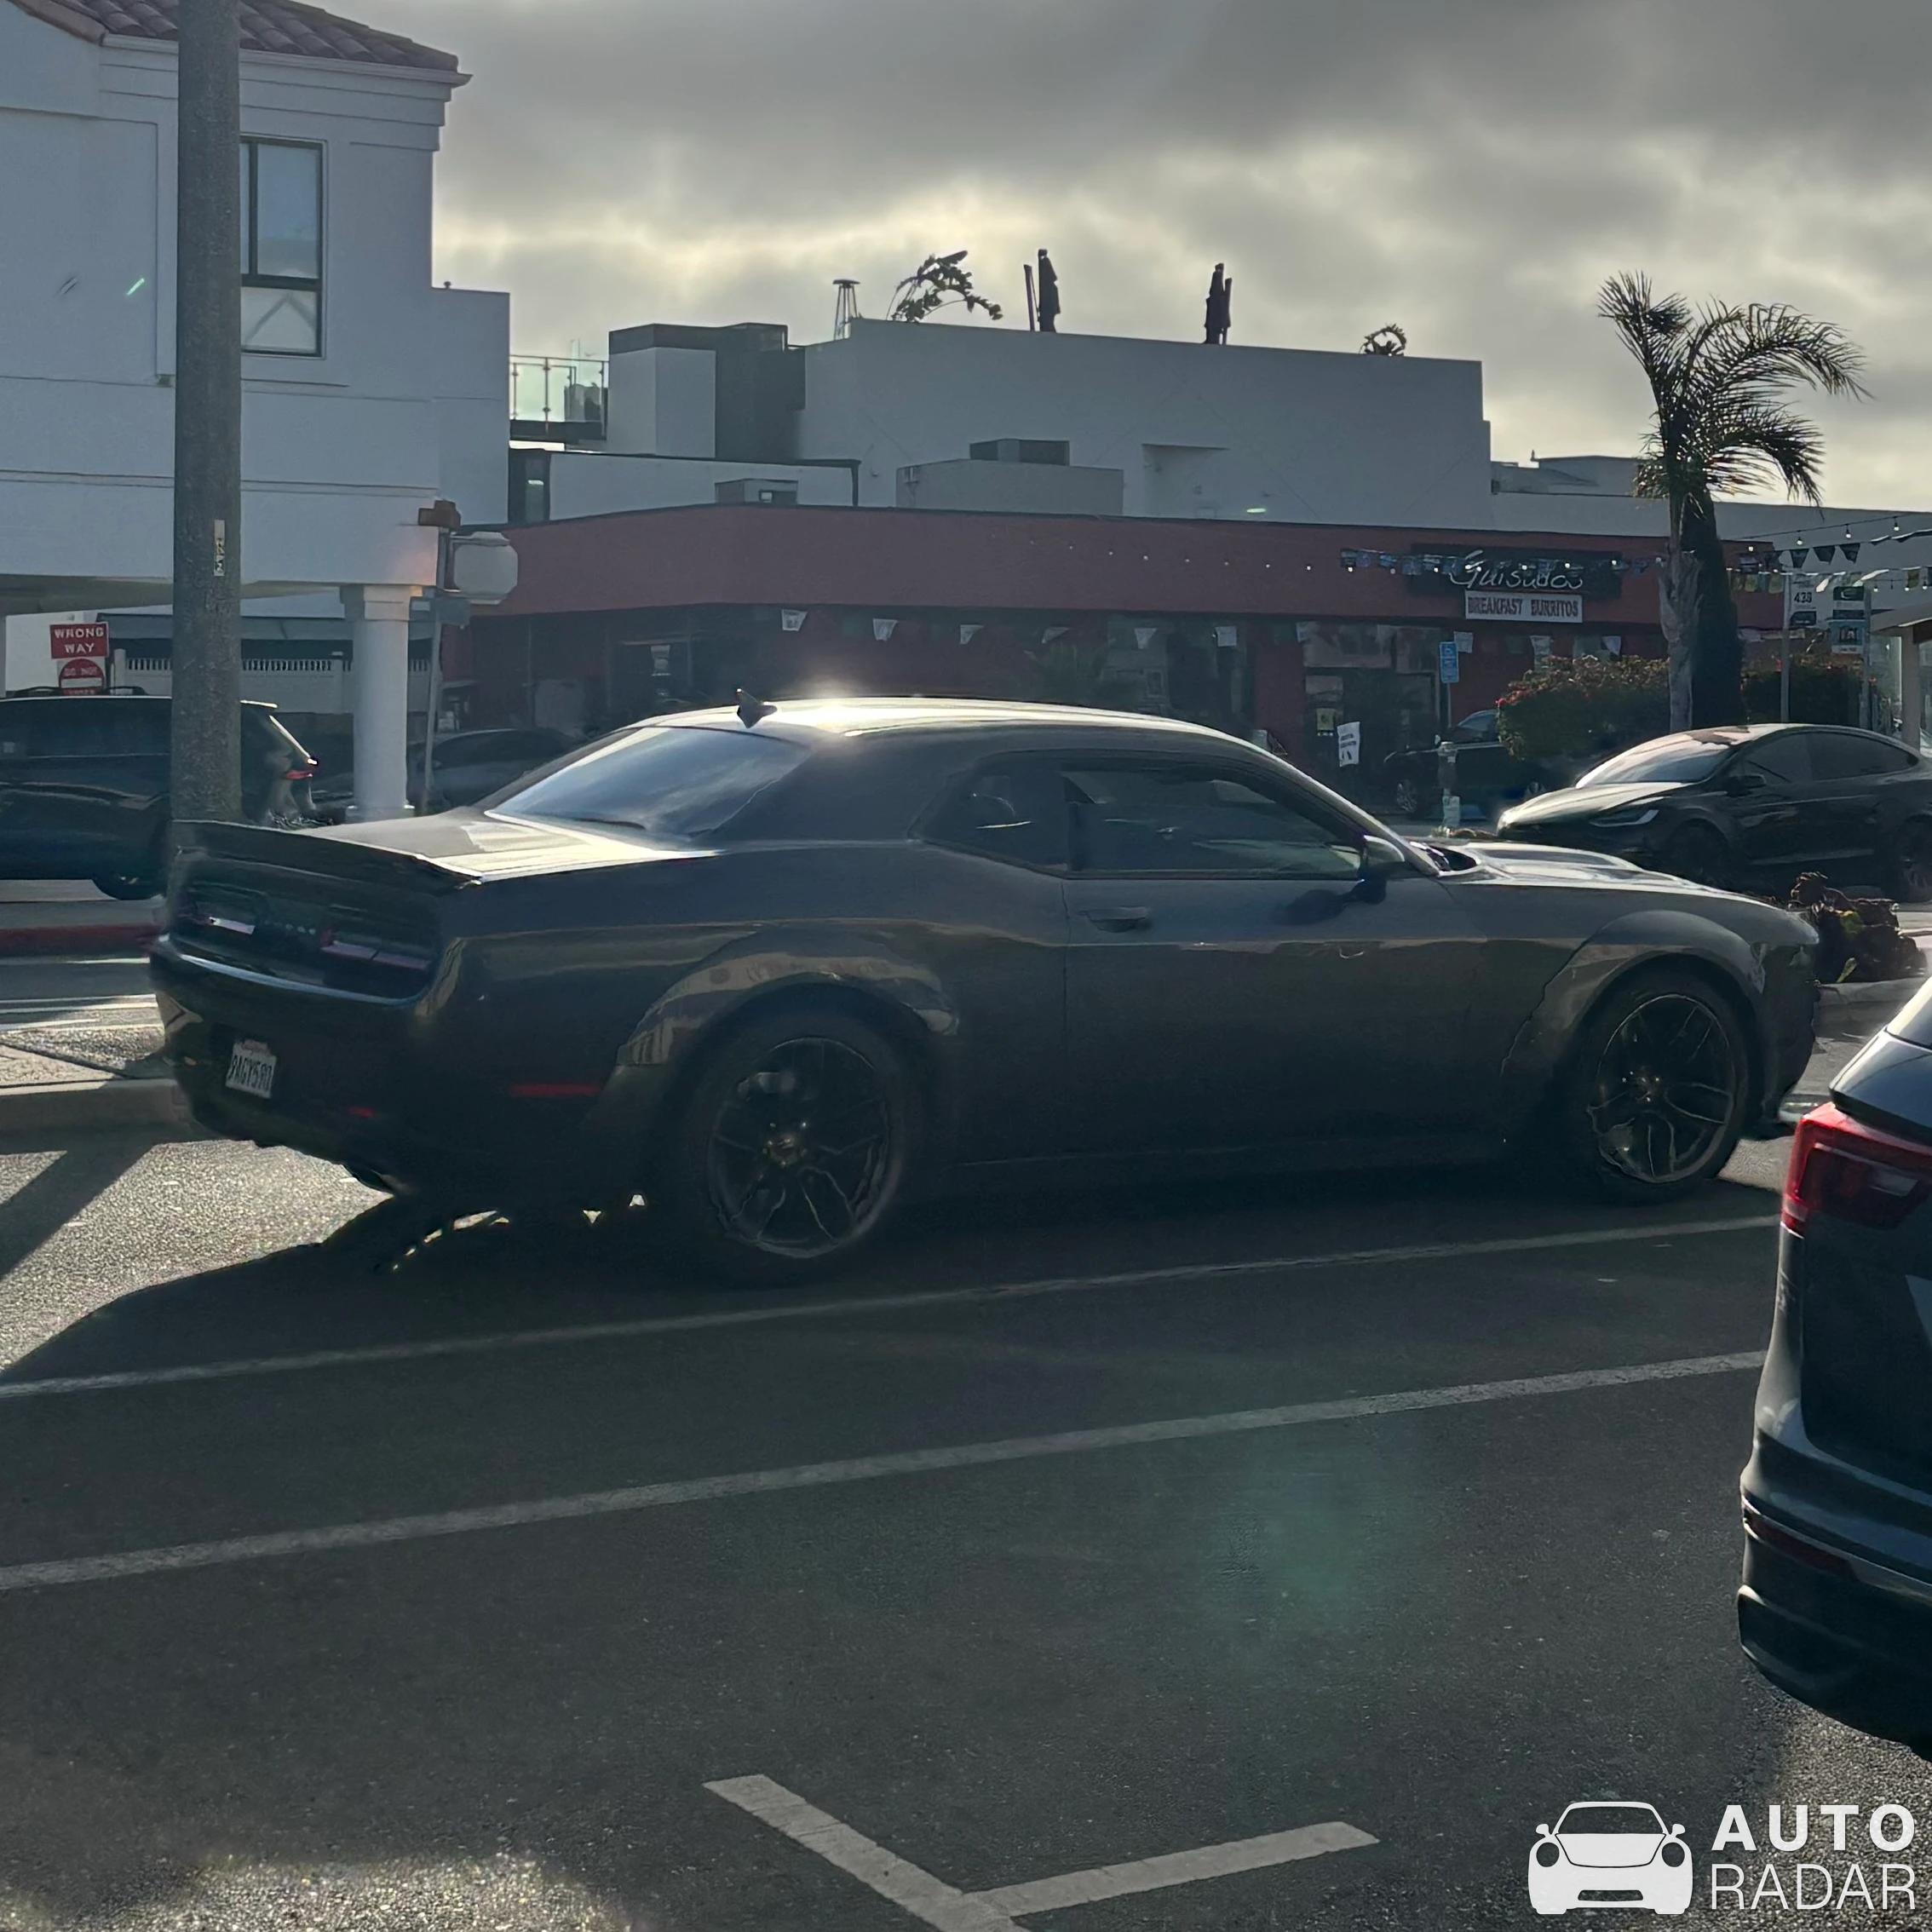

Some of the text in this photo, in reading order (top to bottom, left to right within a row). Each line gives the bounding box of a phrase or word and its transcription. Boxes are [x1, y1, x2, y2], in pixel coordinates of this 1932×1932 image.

[1468, 596, 1578, 618] BREAKFAST BURRITOS
[54, 627, 104, 639] WRONG
[64, 643, 95, 653] WAY
